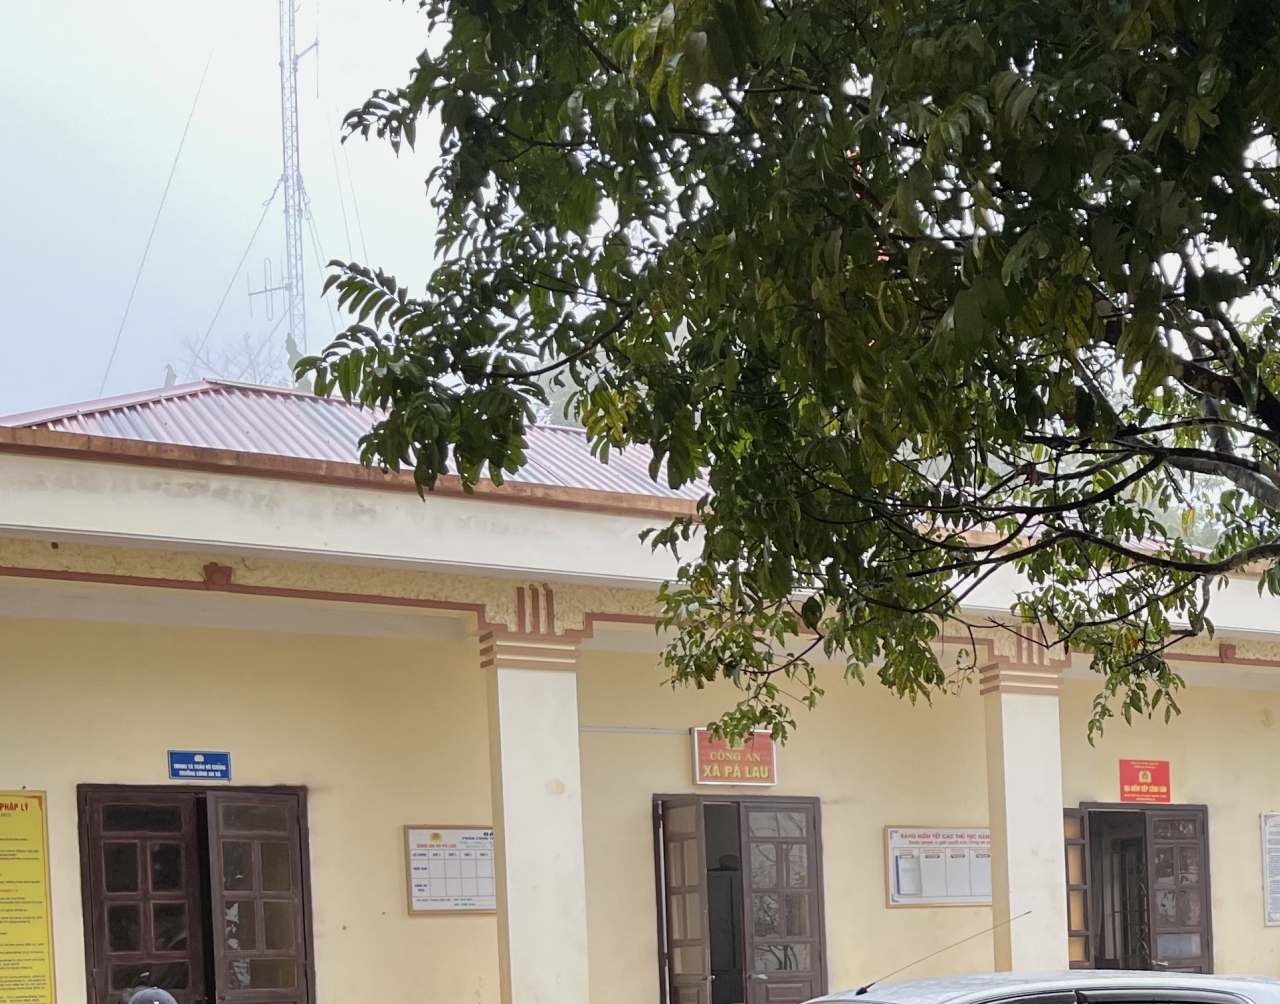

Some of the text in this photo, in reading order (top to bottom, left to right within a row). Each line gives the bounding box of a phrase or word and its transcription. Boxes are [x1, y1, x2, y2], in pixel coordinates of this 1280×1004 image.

[709, 750, 761, 762] CÔNG AN
[745, 766, 769, 778] LAU
